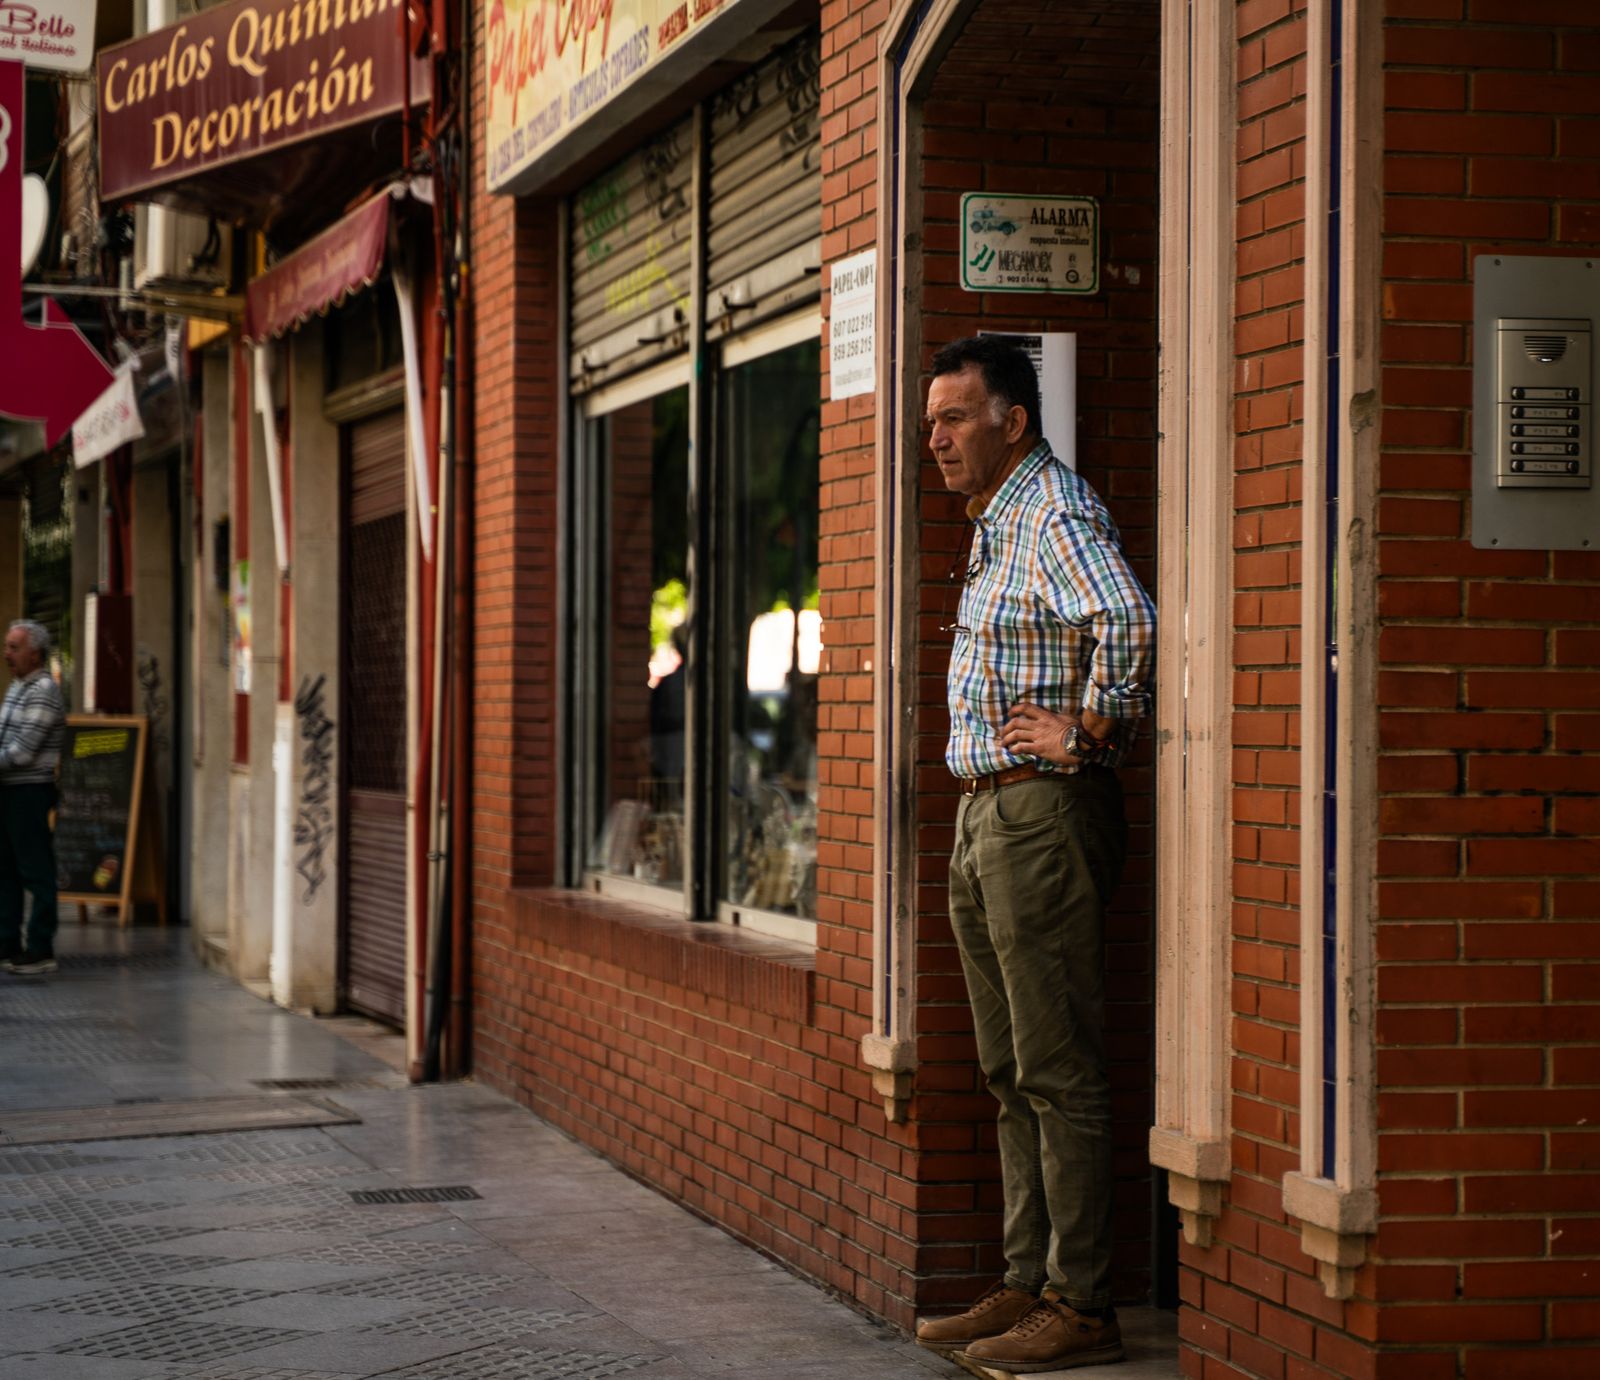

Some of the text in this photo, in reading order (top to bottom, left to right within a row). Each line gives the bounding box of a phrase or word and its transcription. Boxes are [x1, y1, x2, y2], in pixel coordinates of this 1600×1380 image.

[0, 3, 75, 37] Bello
[104, 25, 214, 114] Carlos
[149, 46, 375, 171] Decoración
[1030, 207, 1090, 227] ALARMA
[833, 264, 873, 295] PAPEL-COPY
